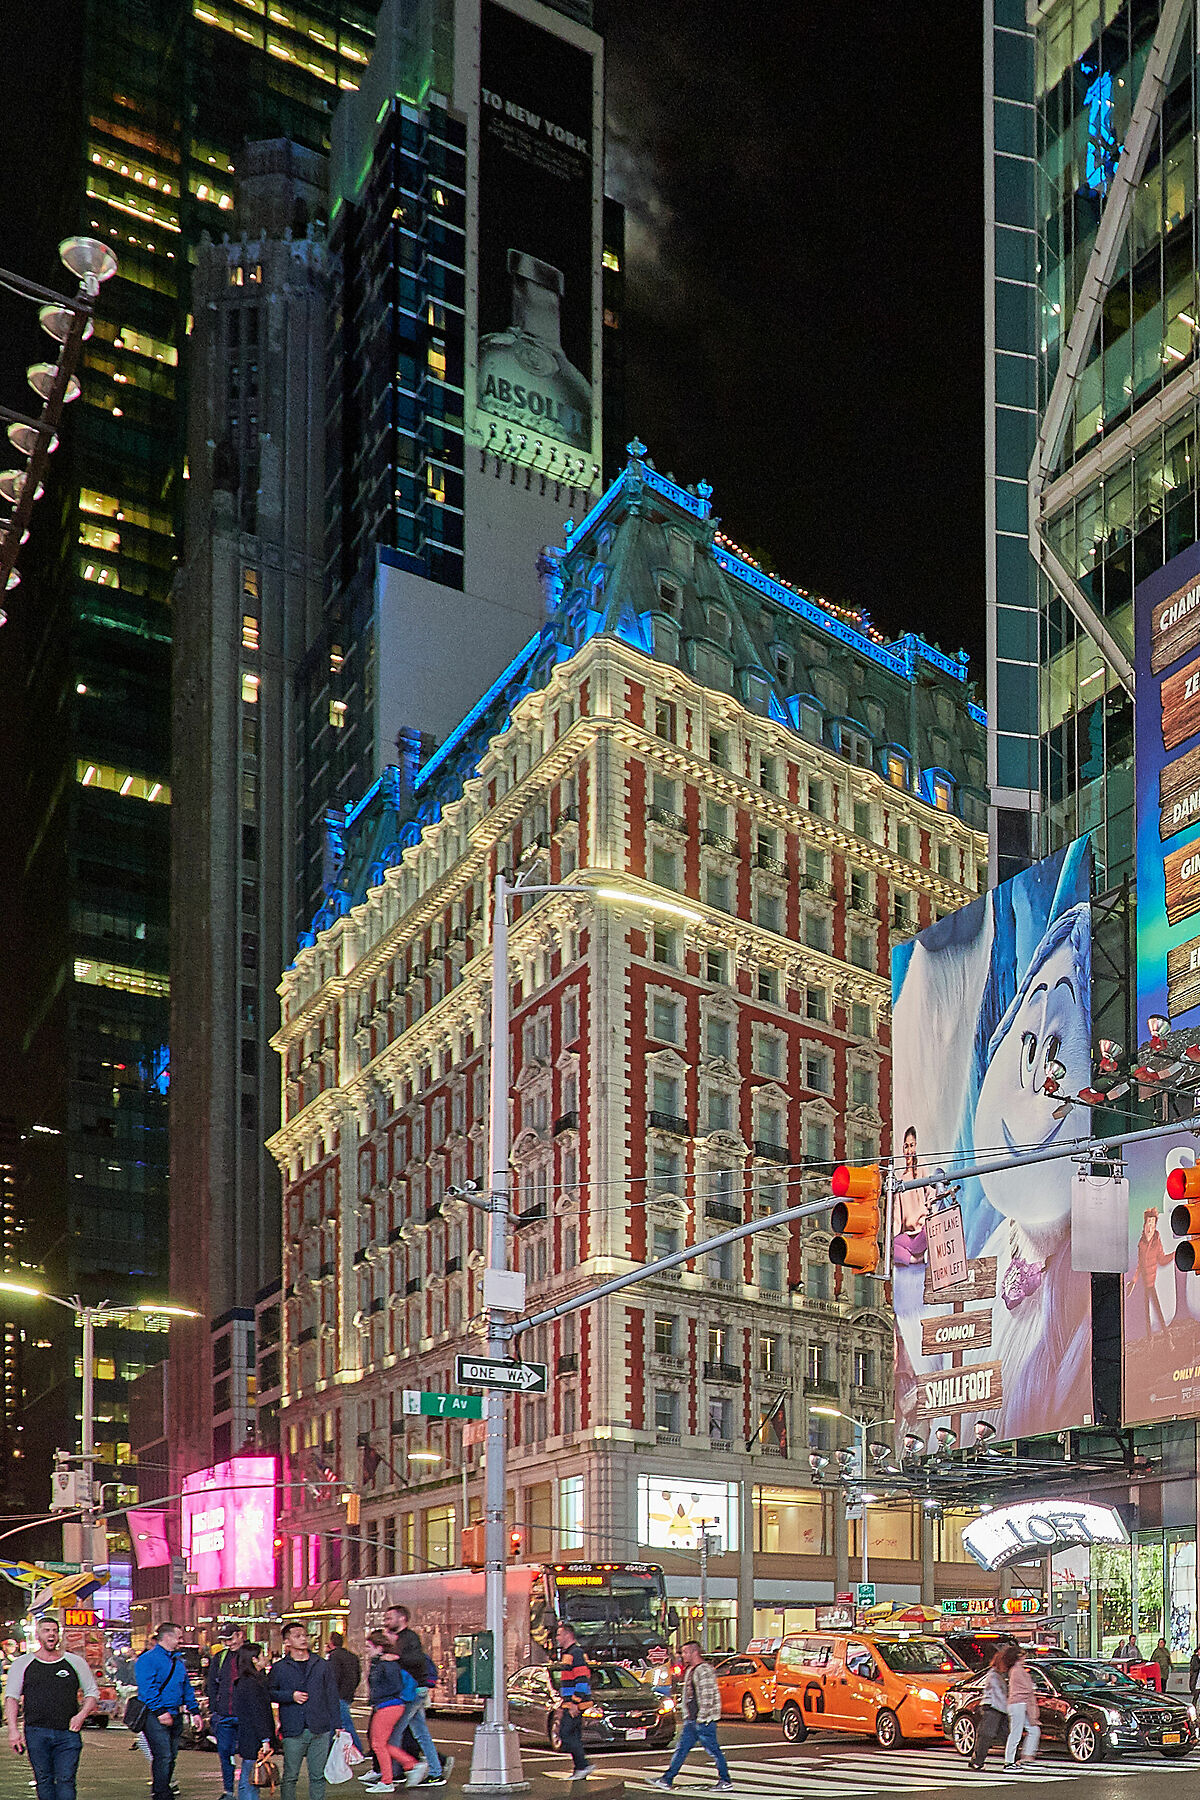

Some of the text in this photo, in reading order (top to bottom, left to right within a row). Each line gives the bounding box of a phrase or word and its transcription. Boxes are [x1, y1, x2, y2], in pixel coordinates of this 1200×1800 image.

[481, 87, 503, 110] TO
[505, 100, 541, 130] NEW
[545, 119, 592, 156] YORK
[484, 374, 582, 434] ABSOL
[928, 1215, 960, 1239] LEFT LANE
[936, 1239, 956, 1258] MUST
[933, 1267, 949, 1282] TURN
[949, 1260, 964, 1276] LEFT
[935, 1323, 977, 1343] COMMON
[470, 1365, 534, 1384] ONE WAY
[1172, 1369, 1194, 1382] ONLY
[925, 1368, 994, 1409] SMALLFOOT
[437, 1396, 468, 1413] 7 Av
[1006, 1511, 1094, 1546] LOFT
[365, 1583, 386, 1609] TOP
[65, 1609, 94, 1626] HOT
